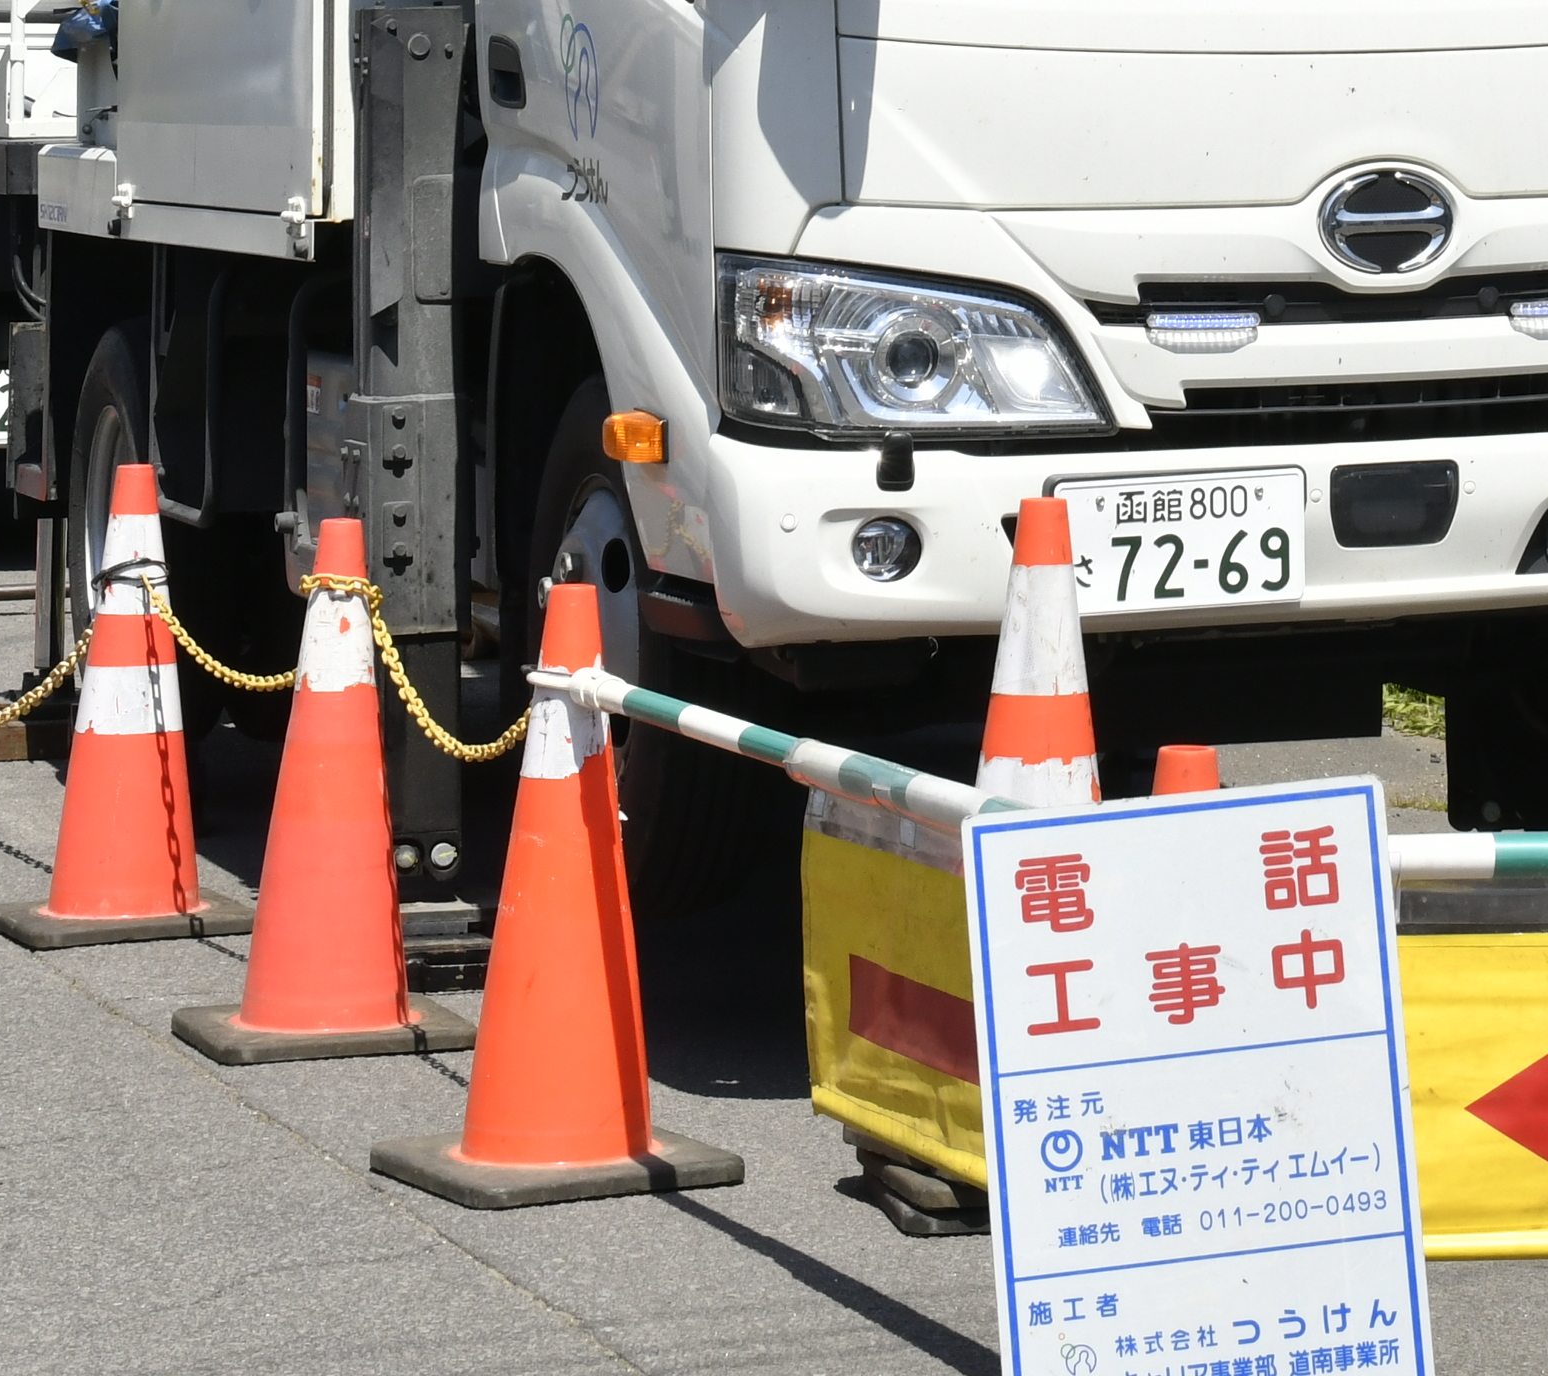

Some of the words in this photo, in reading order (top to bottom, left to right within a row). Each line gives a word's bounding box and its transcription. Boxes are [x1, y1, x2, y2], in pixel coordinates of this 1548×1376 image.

[1111, 527, 1290, 602] 72-69
[1013, 1091, 1104, 1124] 発注元
[1044, 1174, 1083, 1194] NTT
[1058, 1222, 1120, 1249] 連絡先
[1141, 1214, 1183, 1238] 電話
[1199, 1189, 1387, 1231] 011-200-0493
[1028, 1293, 1119, 1327] 施工者
[1115, 1324, 1219, 1358] 株式会社
[1232, 1298, 1397, 1345] つうけん
[1288, 1337, 1400, 1376] 道南事業所
